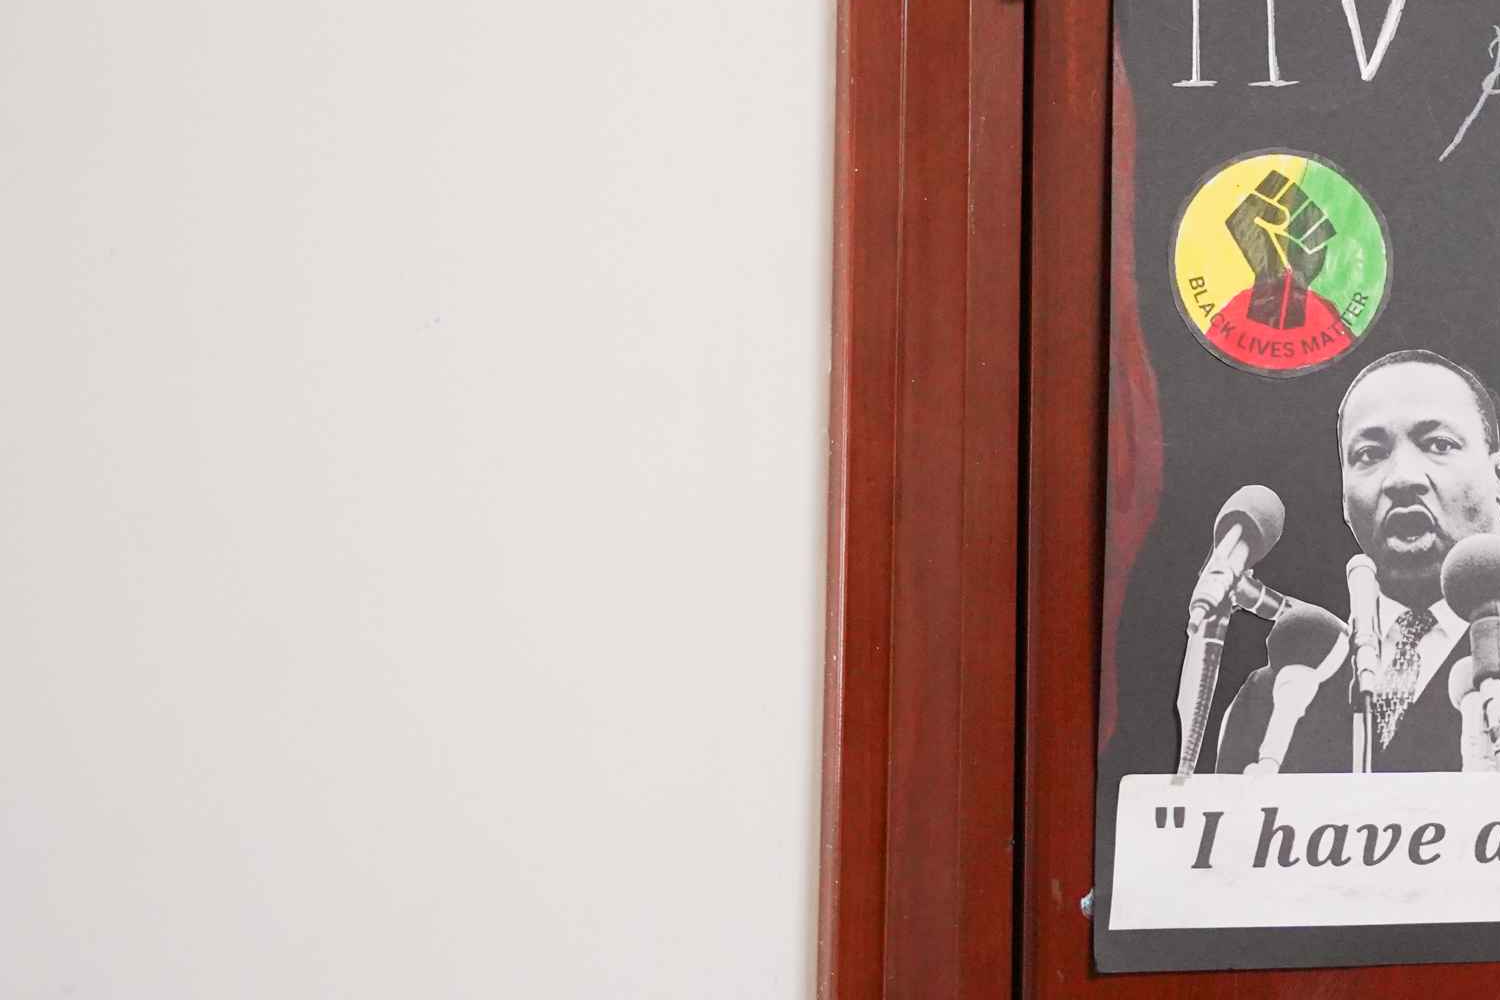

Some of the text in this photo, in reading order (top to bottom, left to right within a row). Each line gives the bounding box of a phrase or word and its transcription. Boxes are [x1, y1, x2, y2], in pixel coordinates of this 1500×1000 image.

[1188, 276, 1370, 359] BLACK LIVES MATTER
[1154, 806, 1227, 870] "I
[1252, 806, 1448, 868] have
